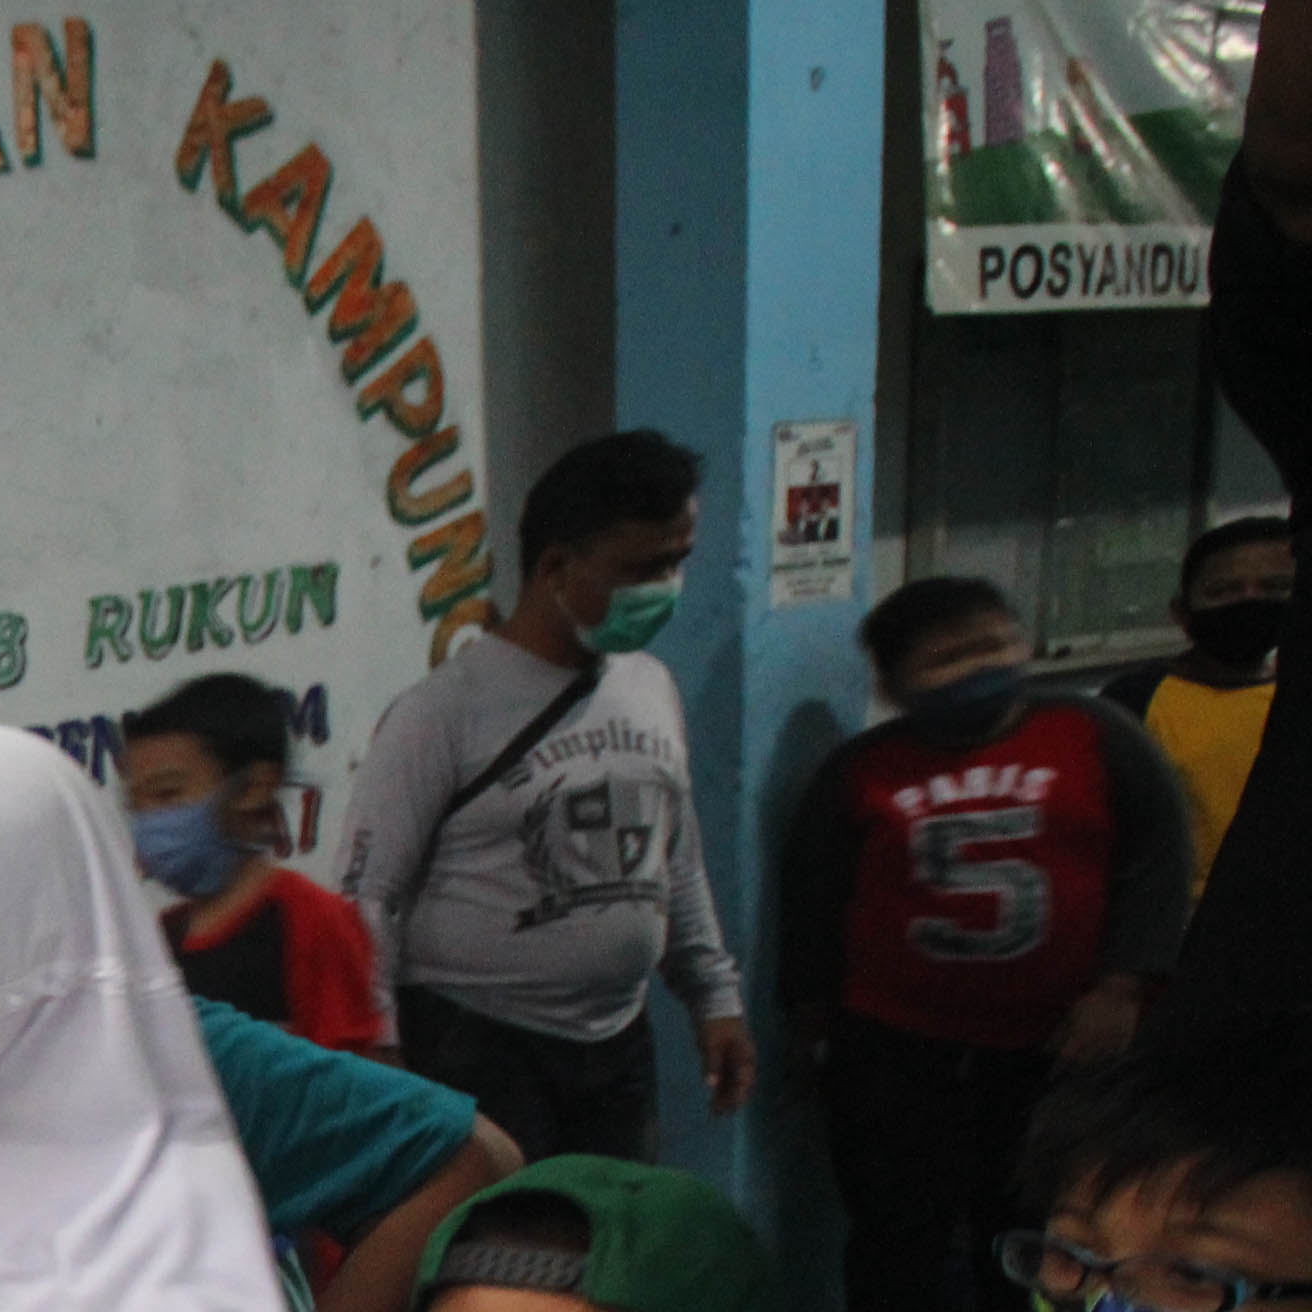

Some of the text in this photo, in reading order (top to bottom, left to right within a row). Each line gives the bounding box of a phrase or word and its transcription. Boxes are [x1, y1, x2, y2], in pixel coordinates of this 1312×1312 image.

[978, 242, 1200, 299] POSYANDU
[84, 561, 340, 671] RUKUN
[906, 803, 1056, 963] 5
